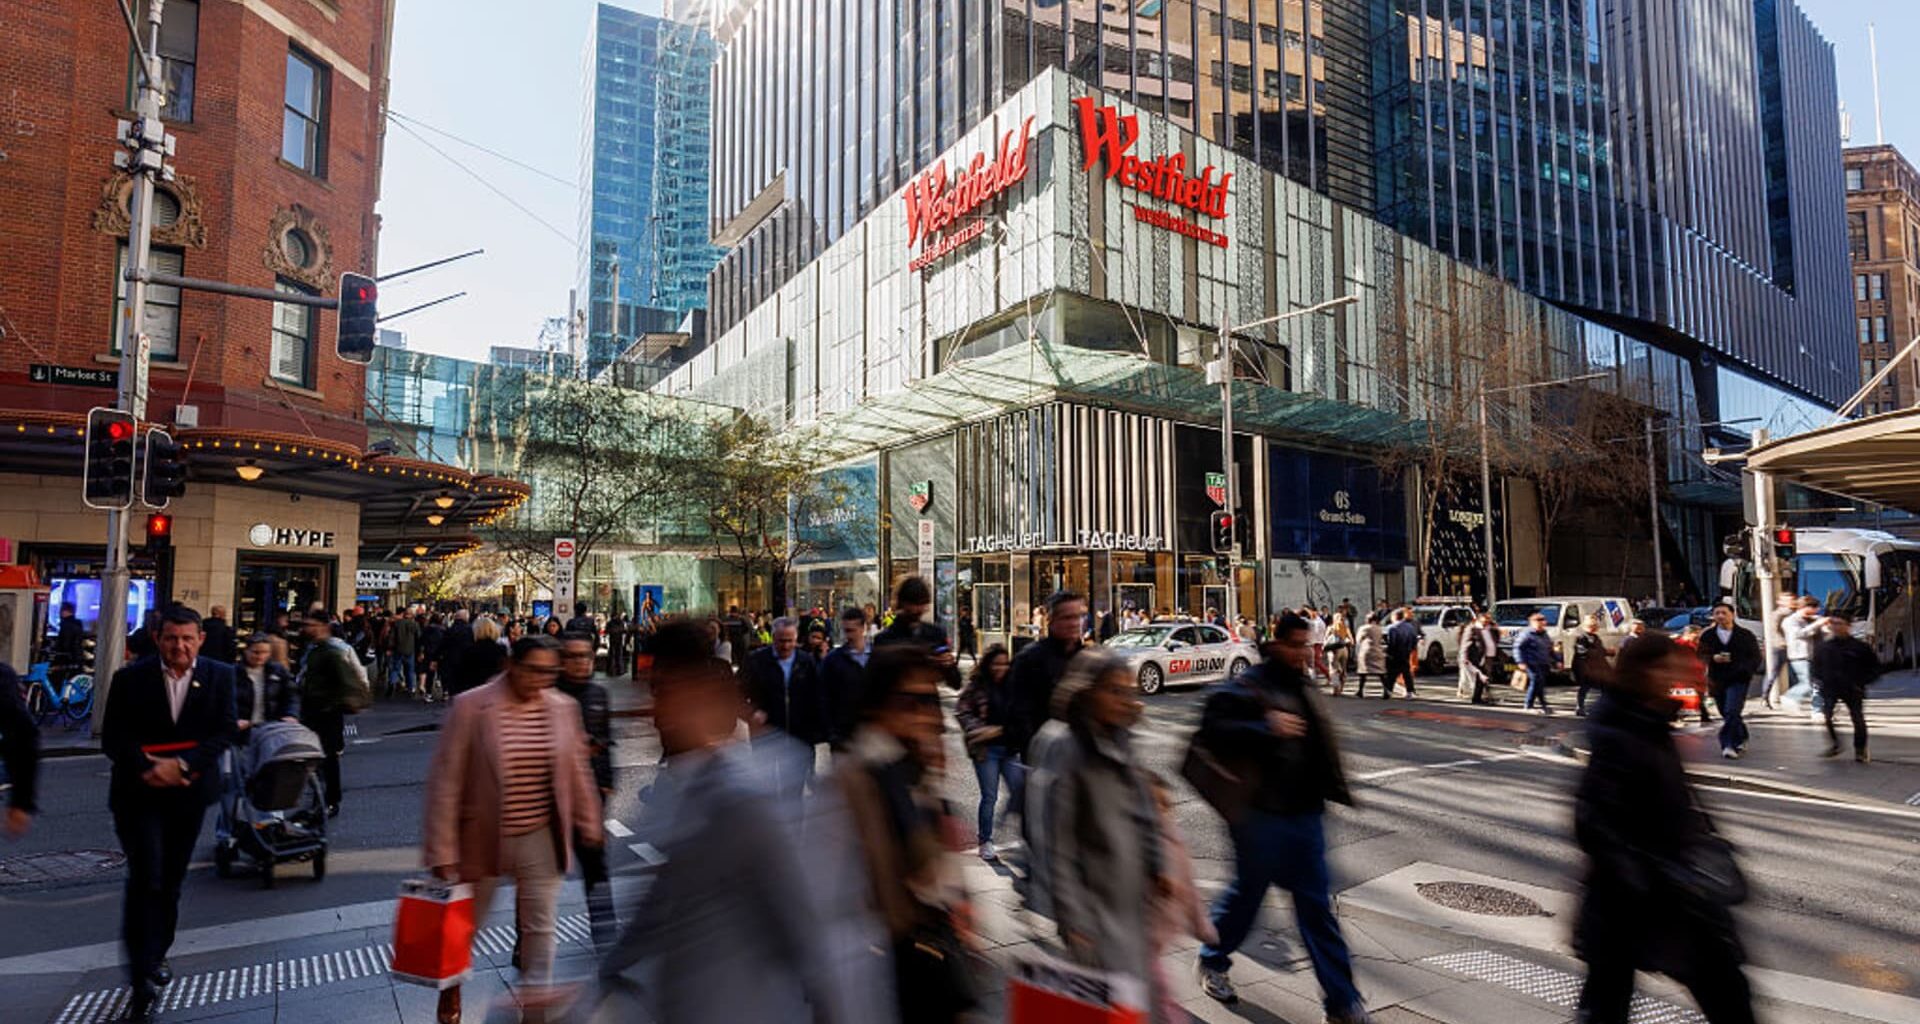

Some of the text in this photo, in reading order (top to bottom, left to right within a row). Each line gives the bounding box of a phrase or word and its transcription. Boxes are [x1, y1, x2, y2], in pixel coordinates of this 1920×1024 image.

[1071, 97, 1233, 220] Westfield
[903, 114, 1035, 249] Westfield
[55, 367, 112, 382] Market St
[273, 528, 335, 548] HYPE
[1168, 659, 1192, 673] GM
